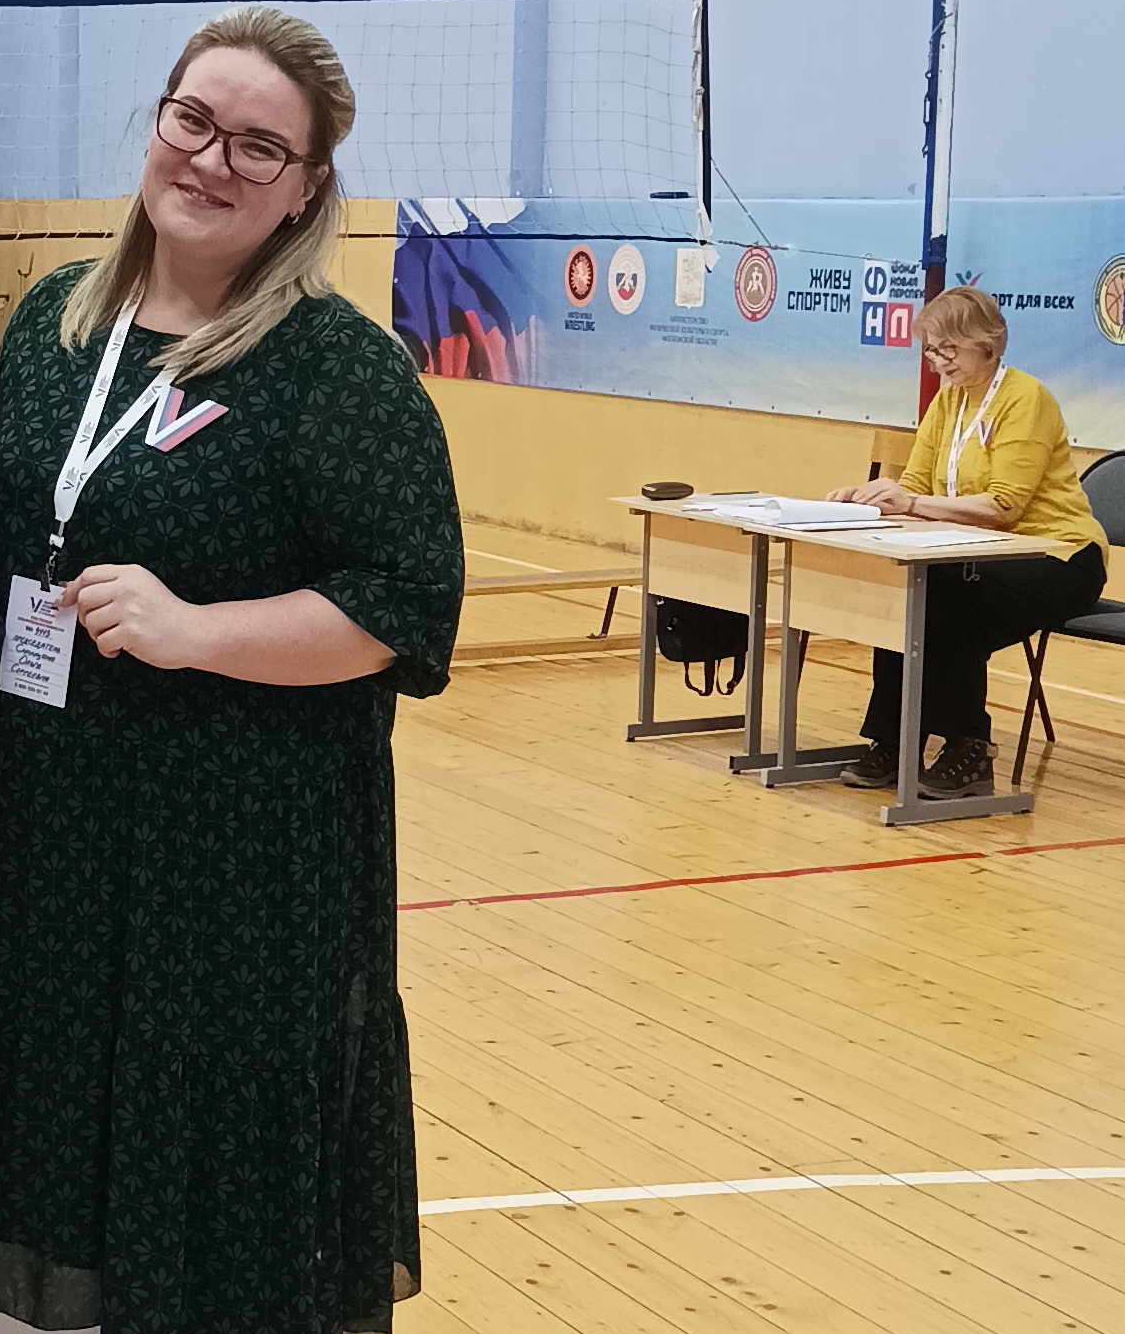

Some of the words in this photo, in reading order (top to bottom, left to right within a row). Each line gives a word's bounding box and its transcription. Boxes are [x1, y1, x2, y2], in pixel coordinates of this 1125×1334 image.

[809, 268, 852, 290] ЖИВУ
[787, 291, 851, 313] СПОРТОМ
[991, 293, 1013, 307] орт
[1015, 294, 1041, 310] для
[1044, 295, 1075, 310] всех
